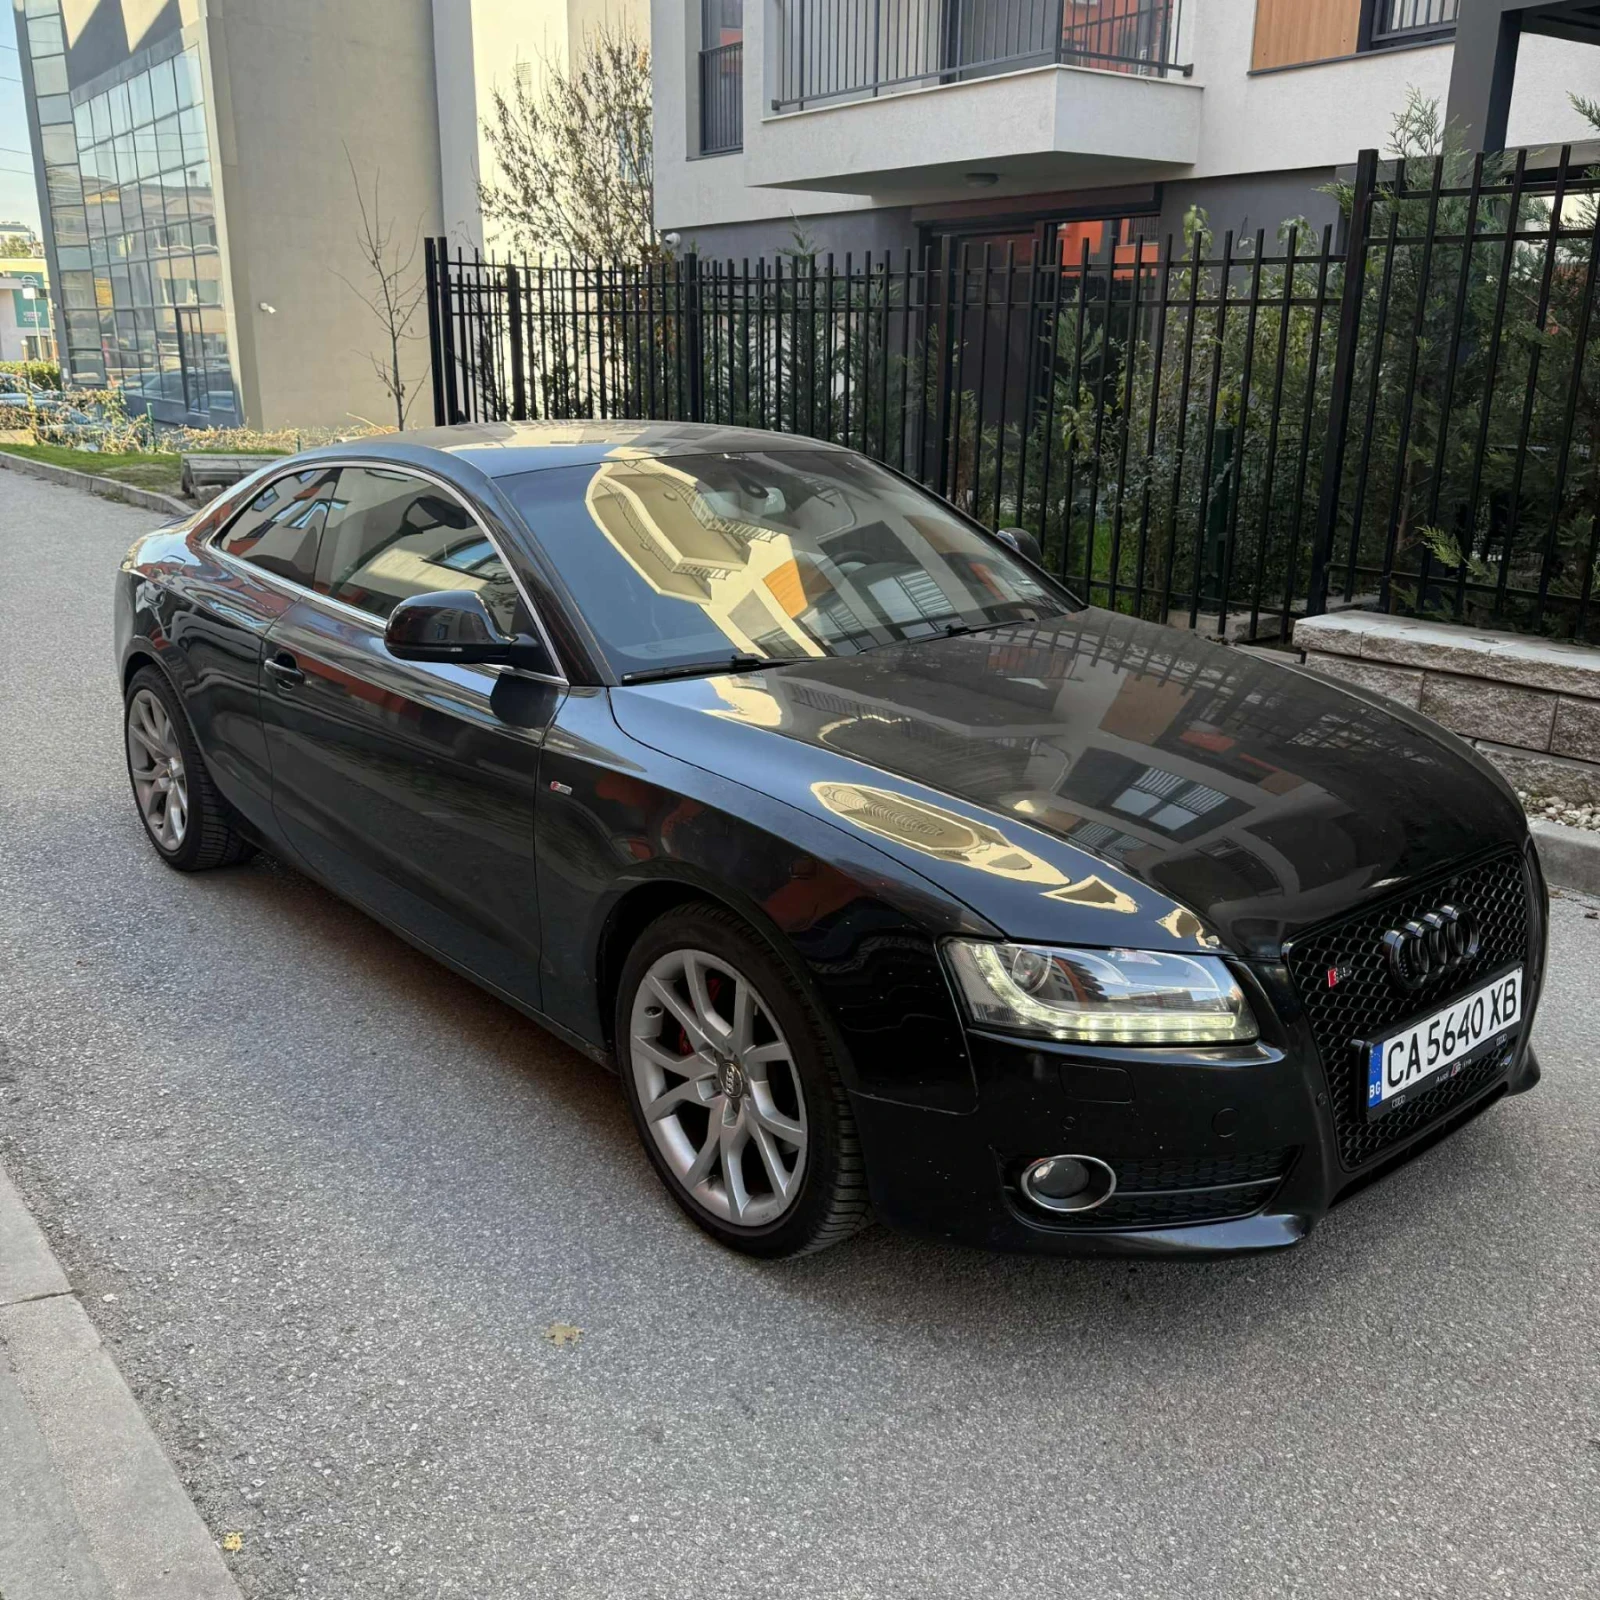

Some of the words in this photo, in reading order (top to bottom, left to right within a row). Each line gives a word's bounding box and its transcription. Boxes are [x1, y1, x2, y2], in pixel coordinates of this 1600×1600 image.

[1387, 1032, 1422, 1088] CA
[1427, 997, 1484, 1066] 5640
[1489, 978, 1517, 1031] XB
[1369, 1081, 1381, 1099] BG
